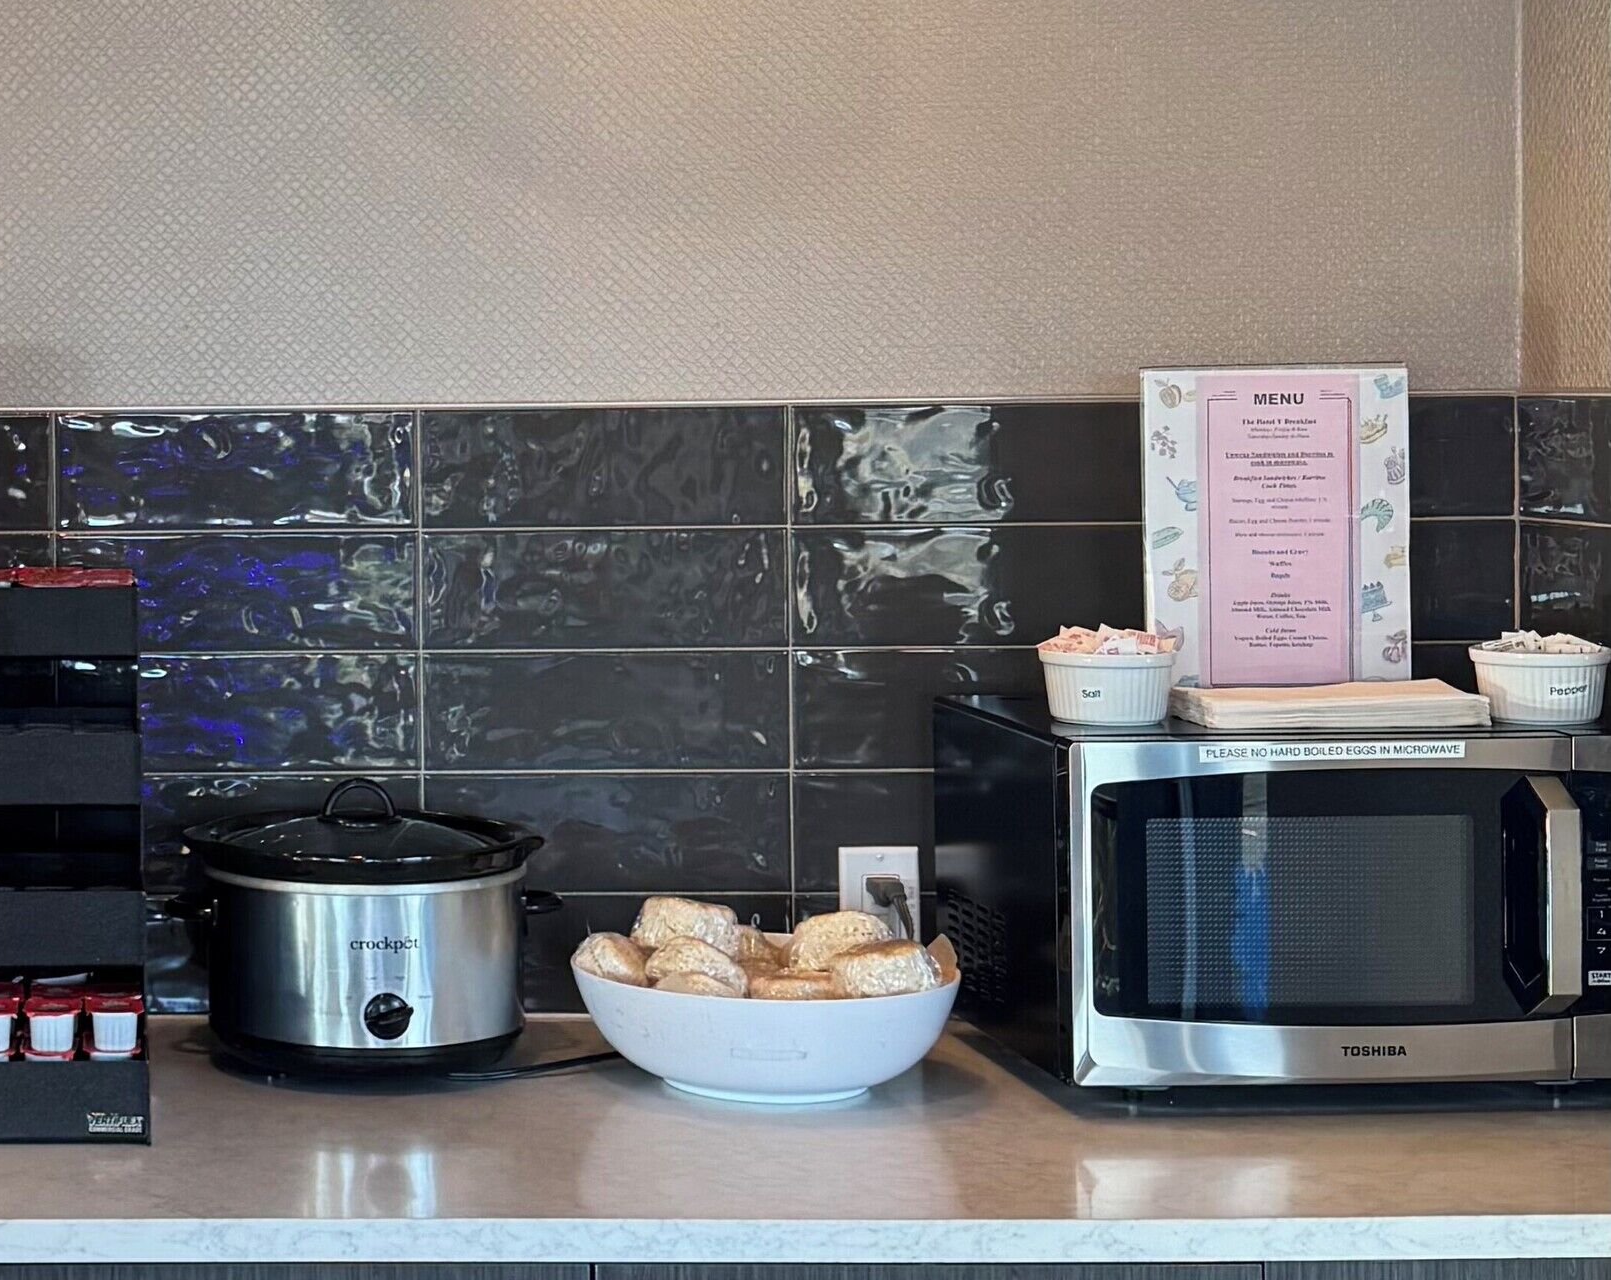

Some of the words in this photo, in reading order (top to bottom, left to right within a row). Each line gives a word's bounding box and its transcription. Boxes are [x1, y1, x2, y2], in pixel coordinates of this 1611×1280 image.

[1254, 393, 1304, 405] MENU
[1081, 689, 1101, 699] Salt
[1550, 683, 1588, 696] Pepper
[1206, 748, 1248, 759] PLEASE
[1251, 747, 1268, 758] NO
[1270, 747, 1301, 757] HARD
[1304, 746, 1344, 757] BOILED
[1346, 746, 1377, 756] EGGS
[1380, 745, 1390, 755] IN
[1393, 744, 1461, 755] MICROWAVE
[1599, 910, 1604, 919] 1
[350, 936, 420, 954] crockpot
[1596, 947, 1606, 955] 7
[1341, 1045, 1407, 1057] TOSHIBA
